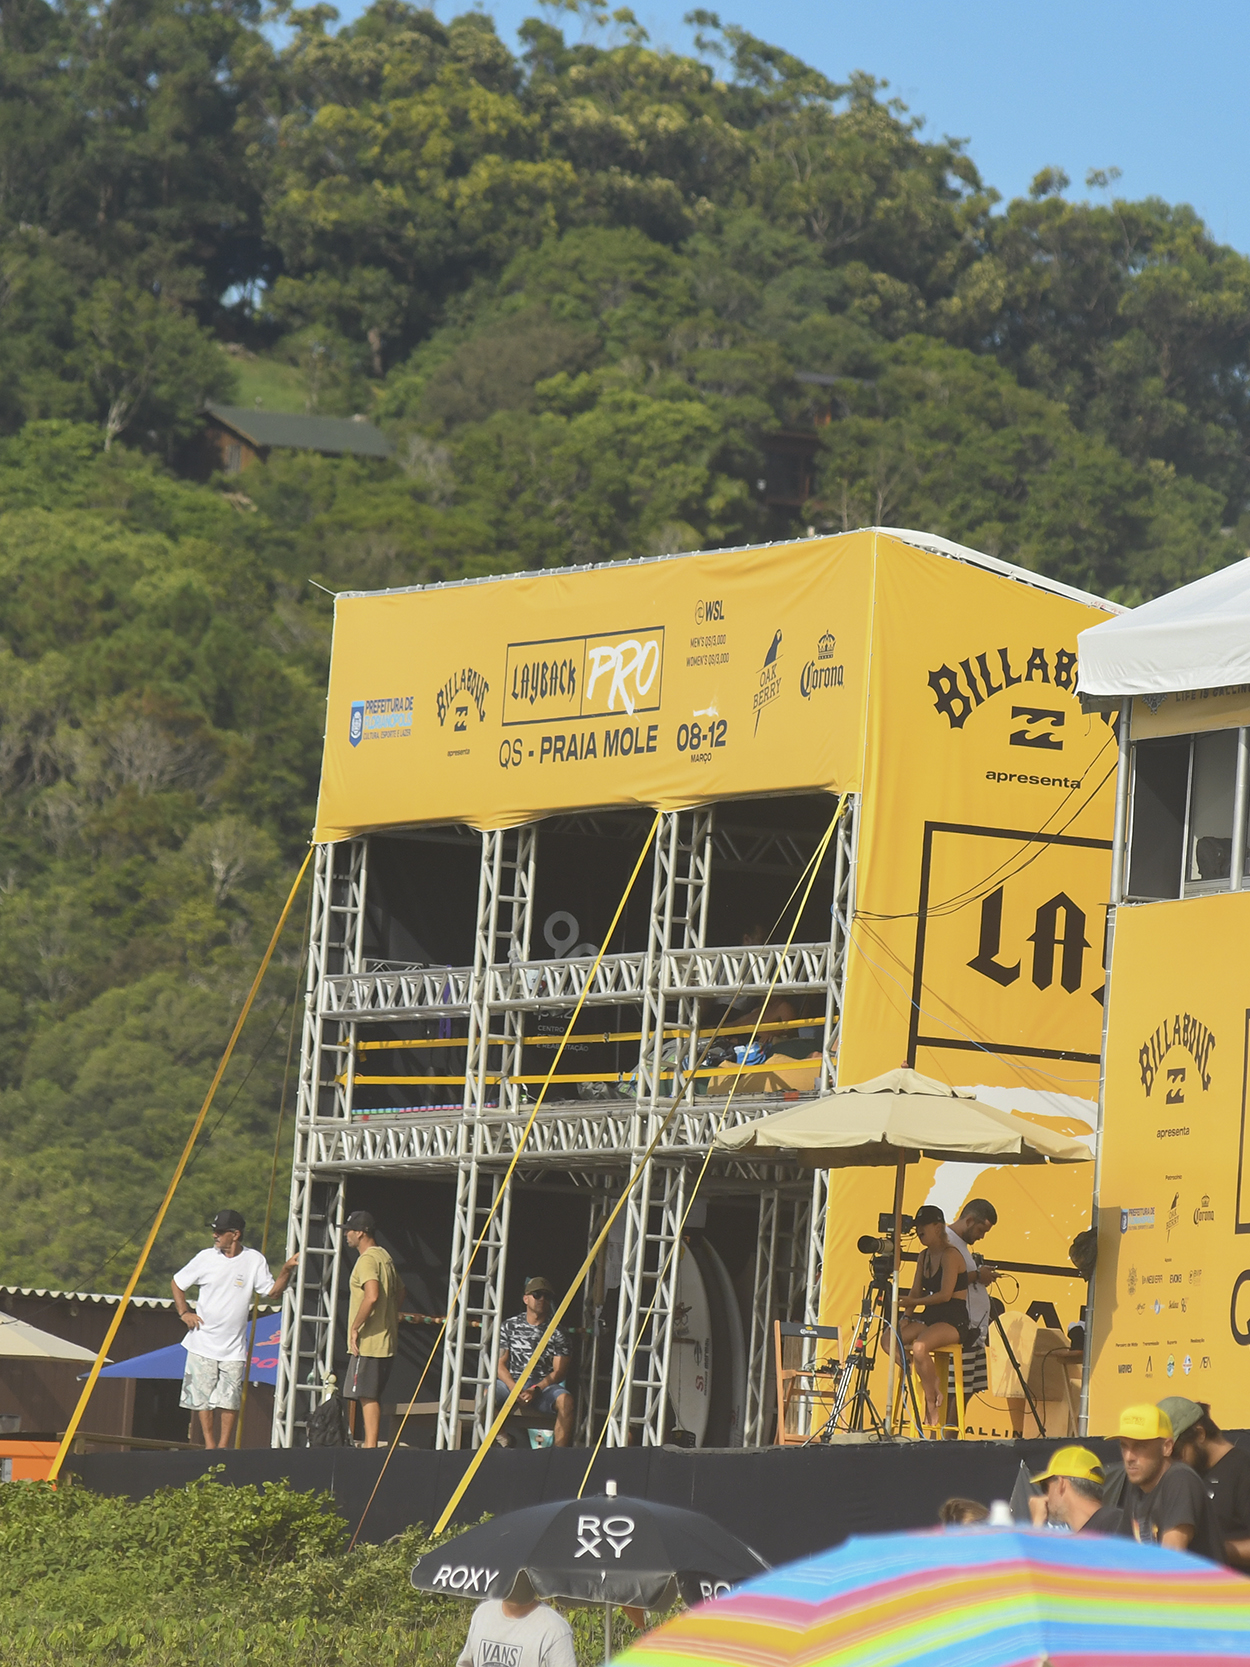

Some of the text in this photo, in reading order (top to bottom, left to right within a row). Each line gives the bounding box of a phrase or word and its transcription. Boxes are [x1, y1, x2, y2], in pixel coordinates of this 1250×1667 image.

[705, 600, 725, 622] WSL
[511, 658, 577, 706] LAYBACK
[586, 639, 660, 717] PRO
[759, 663, 777, 688] OAK
[800, 660, 844, 701] Corona
[365, 696, 414, 714] PREFEITURA DE
[436, 667, 490, 727] BILLABONG
[753, 677, 782, 710] BERRY
[927, 647, 1118, 746] BILLAB
[499, 738, 523, 770] QS
[540, 731, 597, 764] PRAIA
[603, 724, 659, 758] MOLE
[677, 719, 728, 751] 08-12
[690, 752, 712, 764] MARÇO
[985, 769, 1081, 790] apresenta
[537, 1025, 564, 1033] CENTRO
[1138, 1011, 1216, 1098] BILLABONG
[1156, 1126, 1190, 1140] apresenta
[1193, 1207, 1215, 1226] Corona
[965, 1426, 1023, 1439] ALLIN
[577, 1514, 635, 1537] RO
[573, 1537, 633, 1559] XY
[432, 1564, 499, 1593] ROXY
[483, 1641, 518, 1667] VANS
